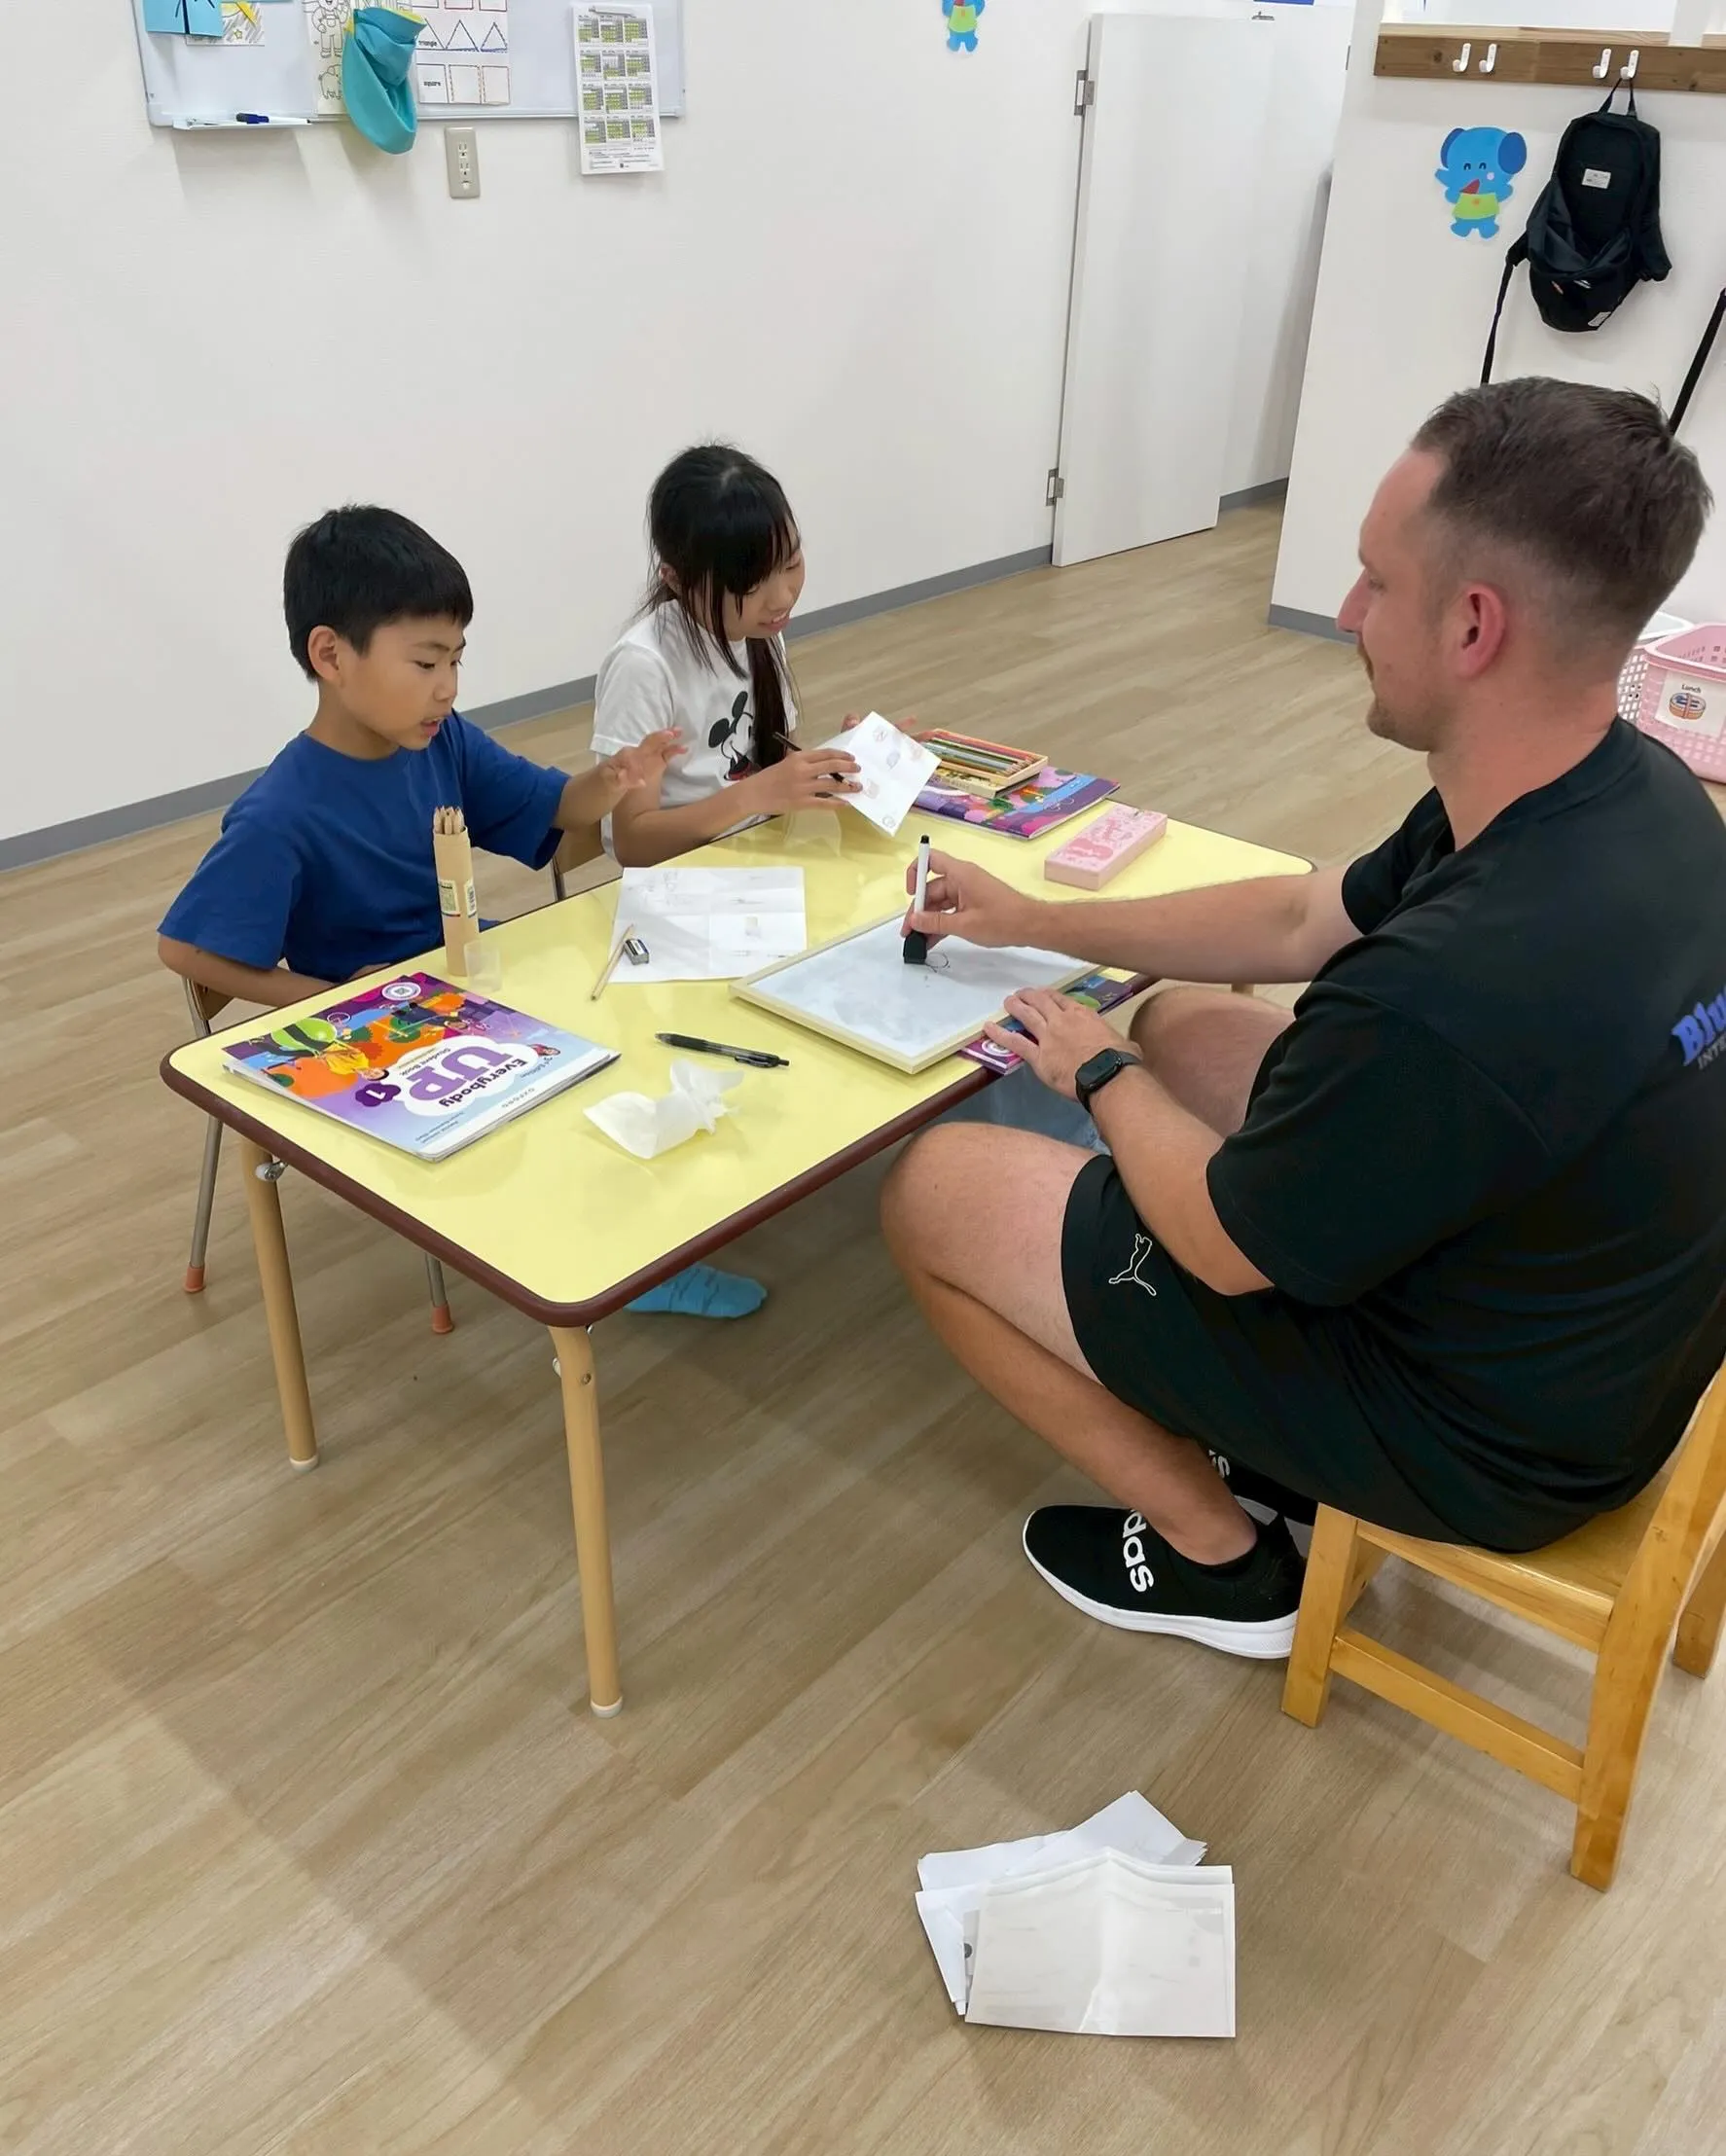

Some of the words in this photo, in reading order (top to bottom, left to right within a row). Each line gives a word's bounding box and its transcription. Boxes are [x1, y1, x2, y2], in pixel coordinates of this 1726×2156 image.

[1681, 682, 1702, 694] Lunch
[1671, 985, 1726, 1066] Blu
[365, 1090, 386, 1100] 1
[406, 1046, 514, 1101] UP
[439, 1058, 528, 1107] Everybody
[1123, 1509, 1155, 1593] das
